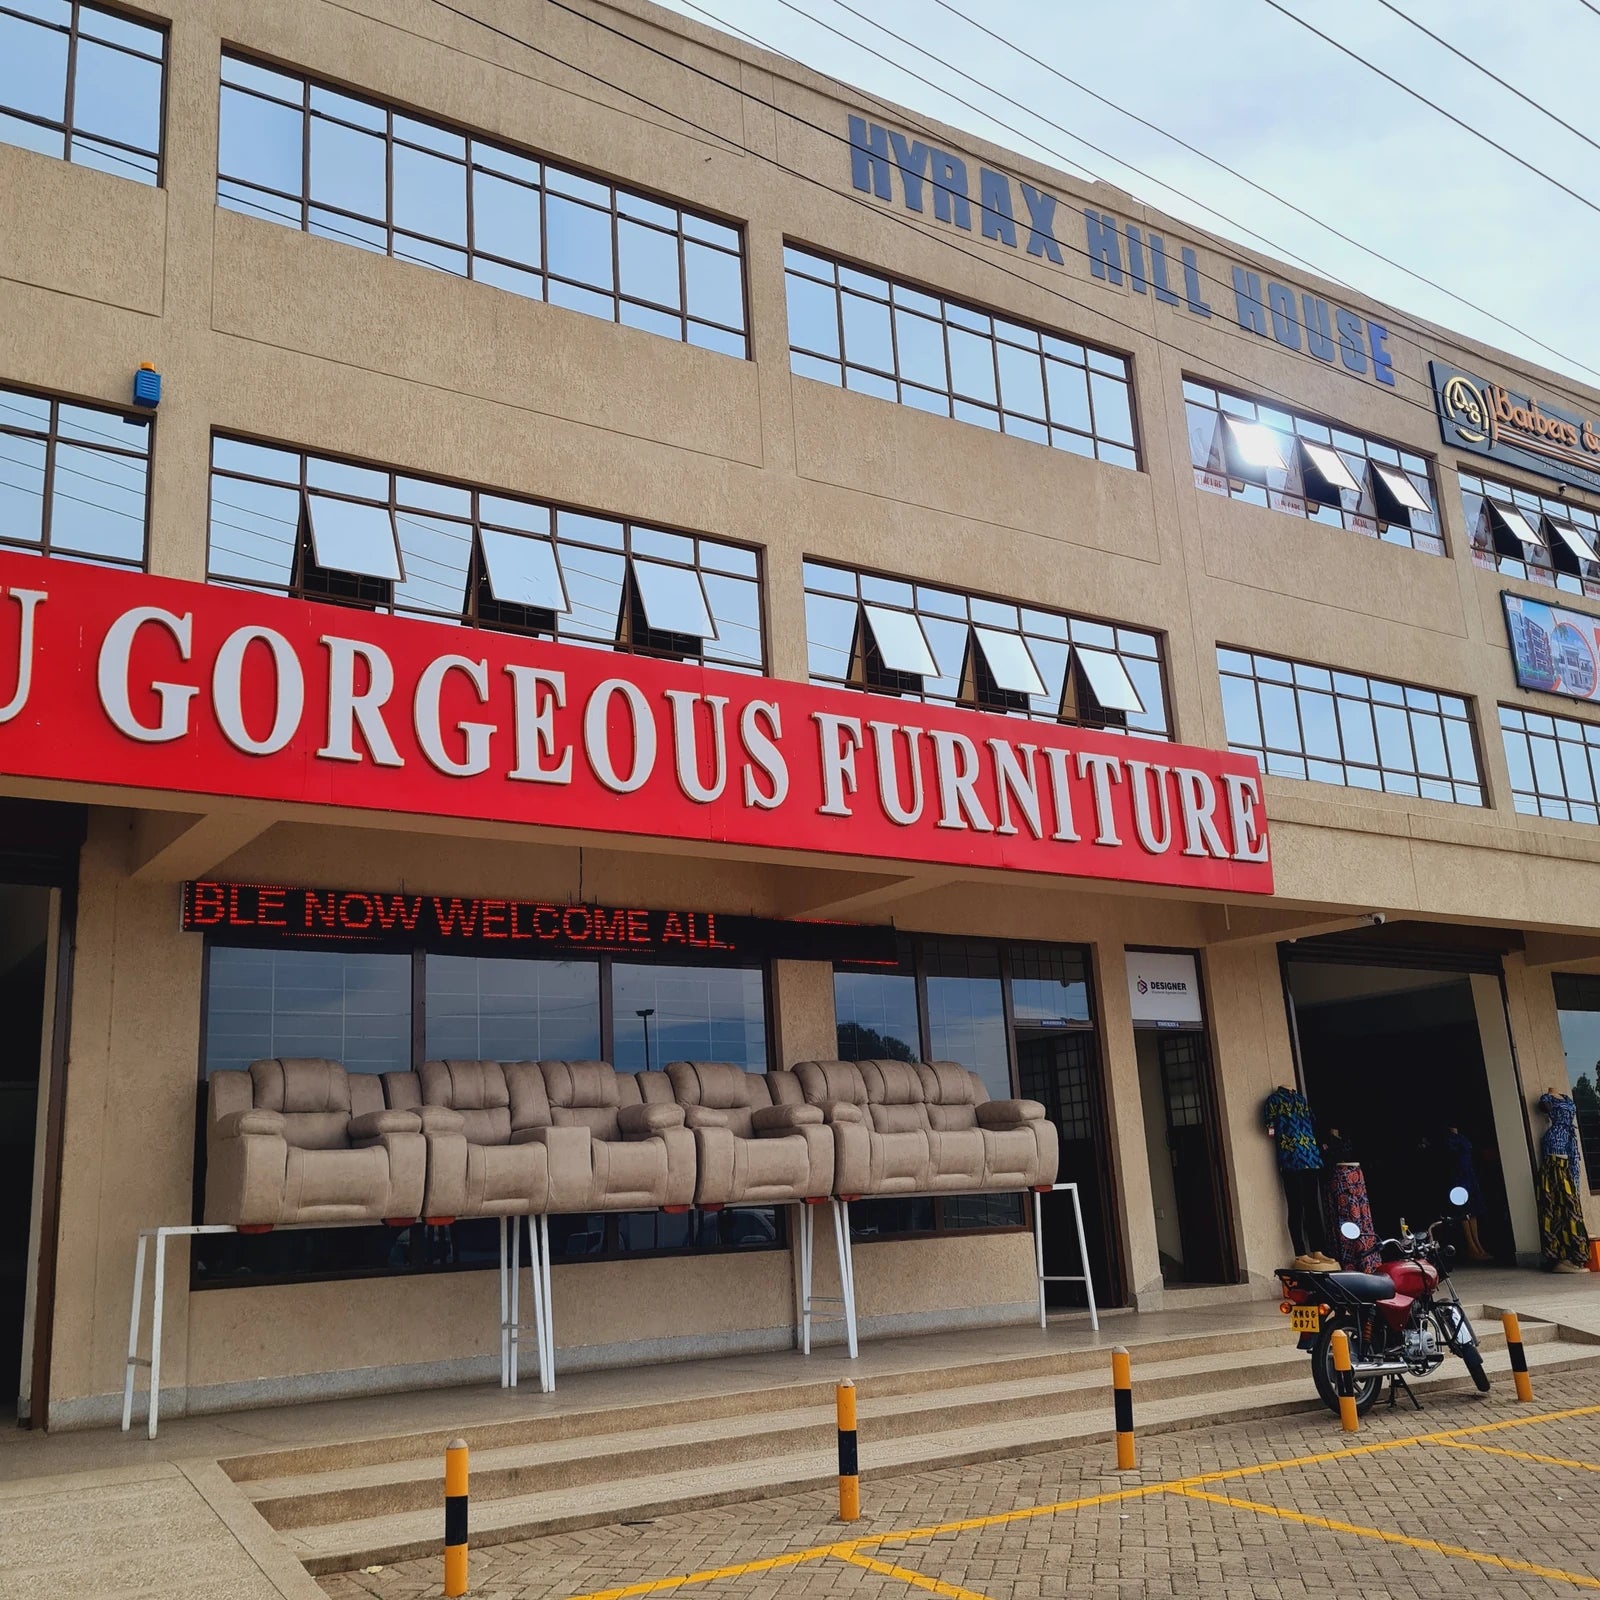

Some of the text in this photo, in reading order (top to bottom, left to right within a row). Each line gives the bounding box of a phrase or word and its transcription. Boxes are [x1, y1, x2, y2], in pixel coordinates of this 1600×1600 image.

[848, 114, 1395, 387] HYRAX HILL HOUSE
[98, 606, 789, 810] GORGEOUS
[811, 711, 1269, 864] FURNITURE
[305, 891, 422, 930] NOW
[433, 896, 651, 943] WELCOME
[1150, 981, 1187, 991] DESIGNER
[1293, 1319, 1317, 1329] 687L
